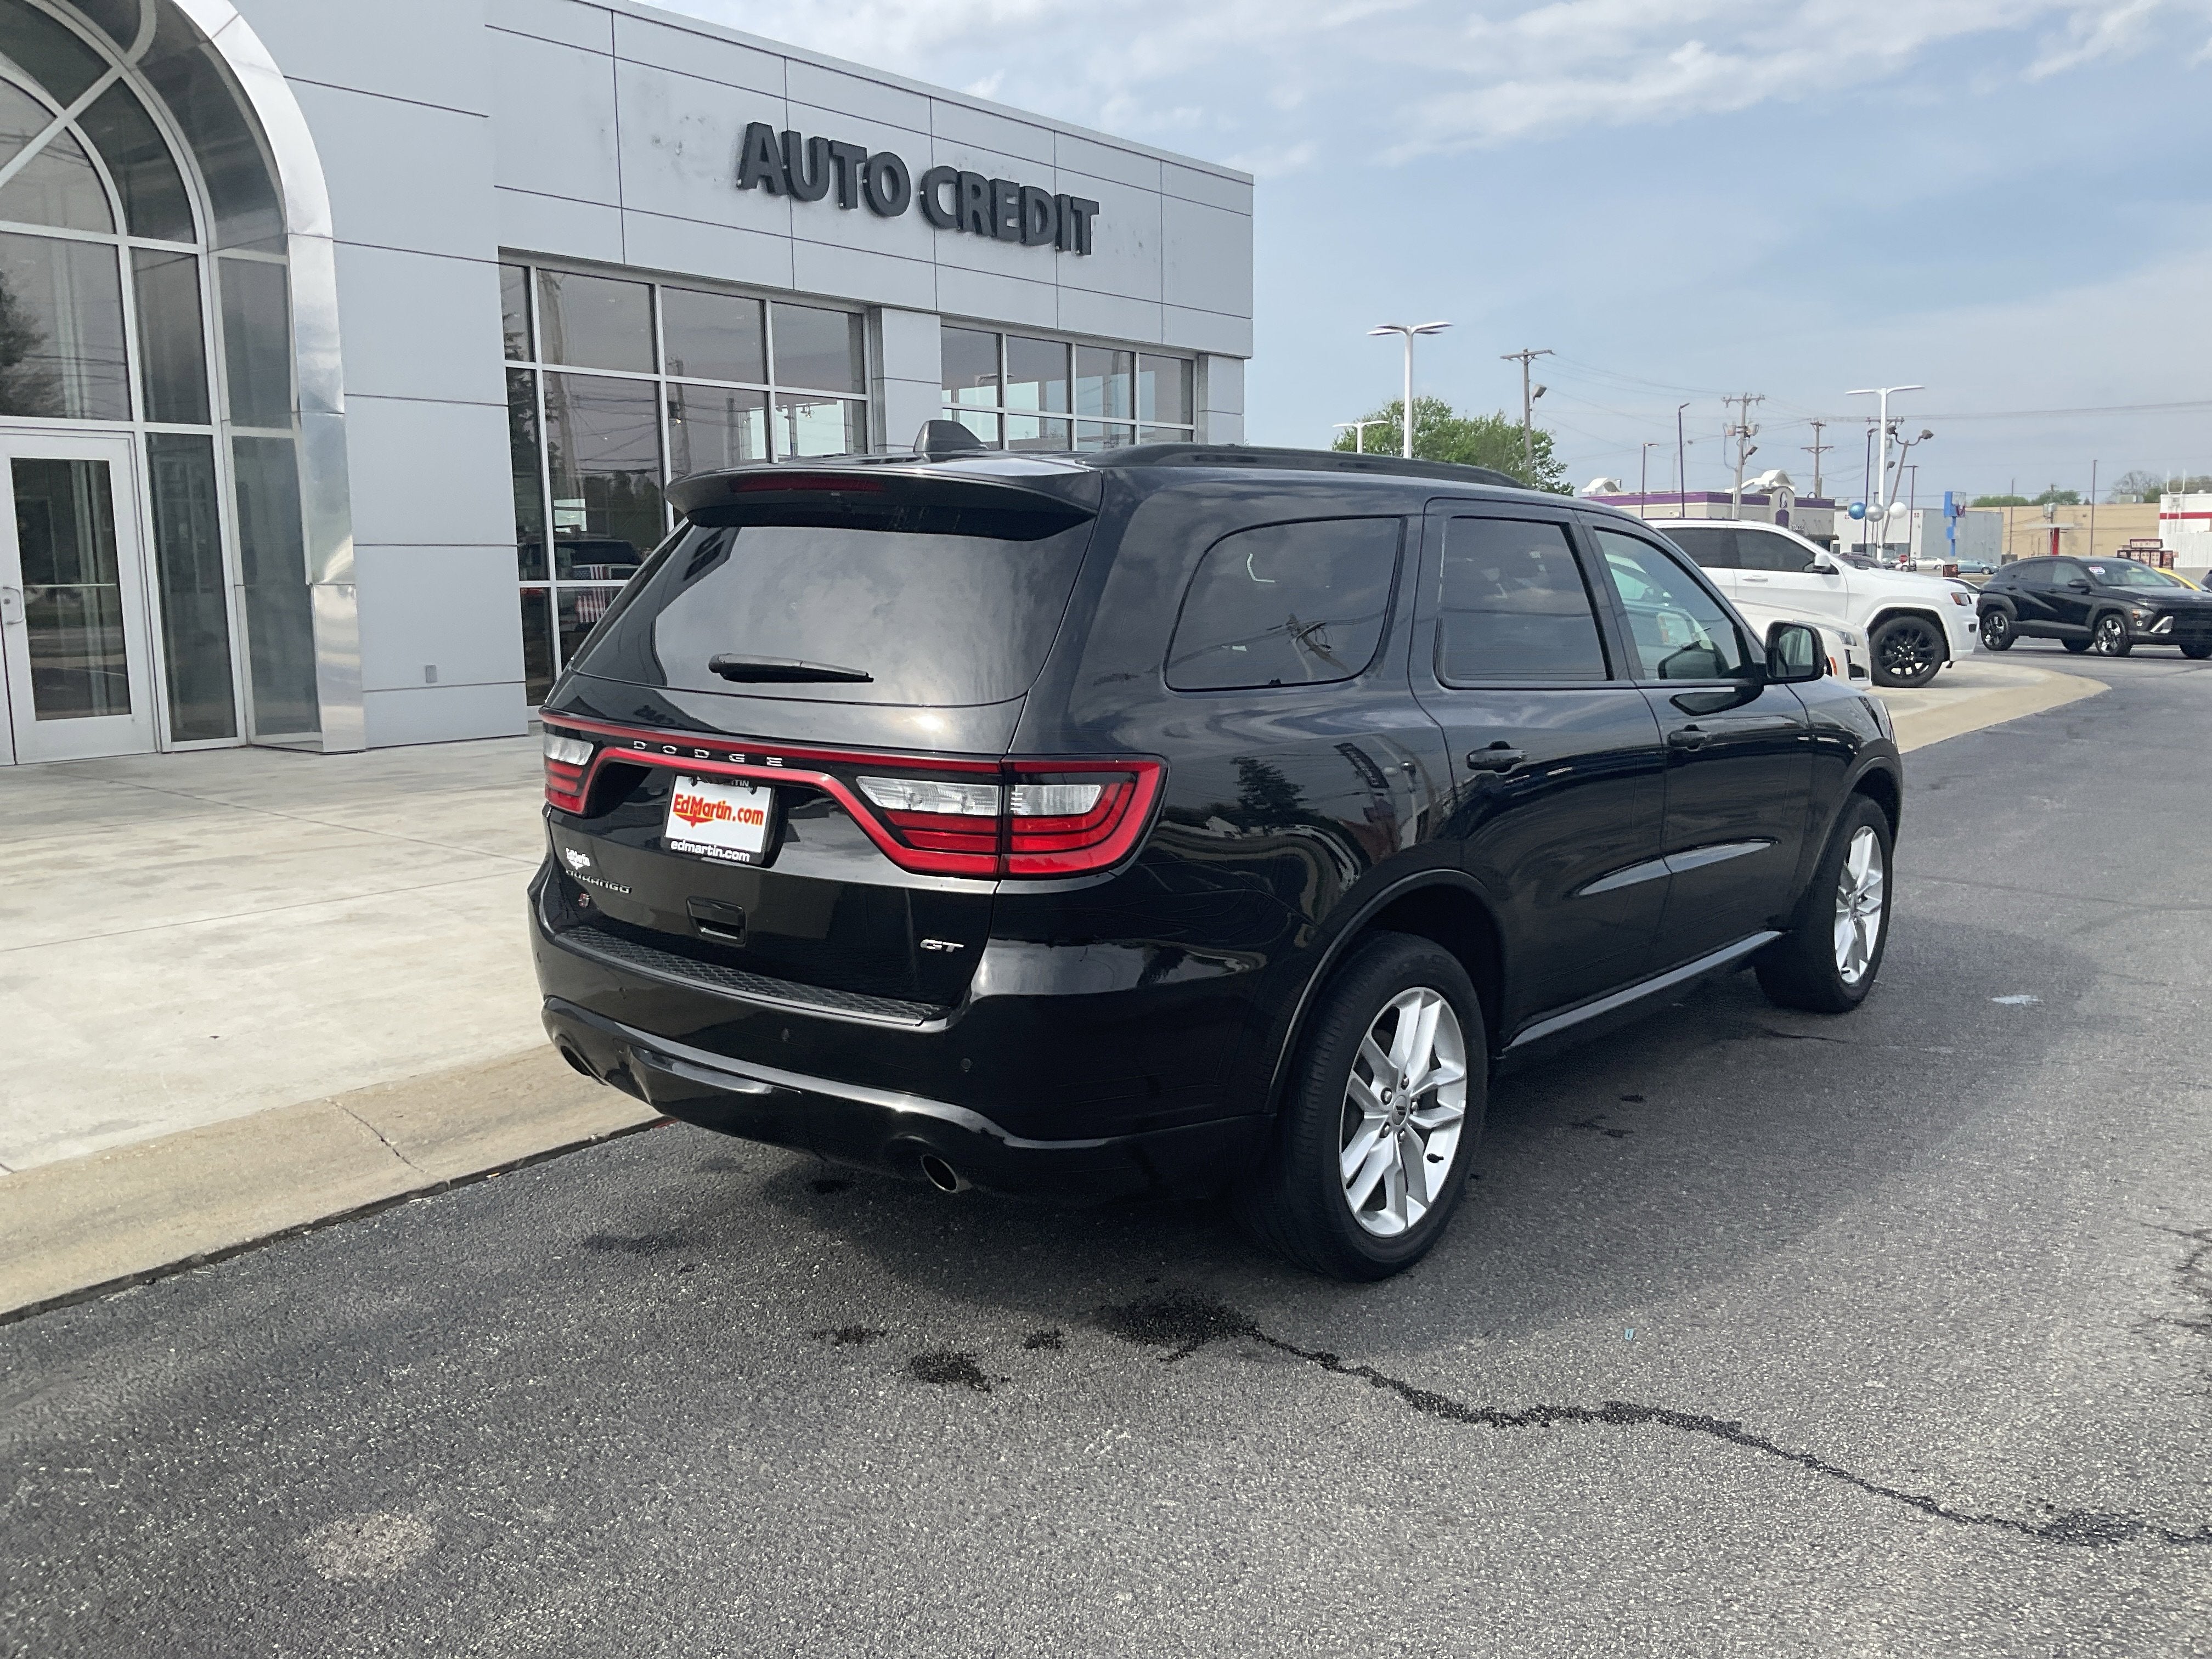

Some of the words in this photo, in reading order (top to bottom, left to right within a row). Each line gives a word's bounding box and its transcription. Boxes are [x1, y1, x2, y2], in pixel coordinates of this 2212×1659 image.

[737, 122, 911, 217] AUTO
[919, 165, 1099, 256] CREDIT
[633, 740, 783, 767] DODGE
[673, 793, 764, 826] EdMartin.com
[670, 840, 751, 862] edmartin.com
[920, 939, 964, 952] GT
